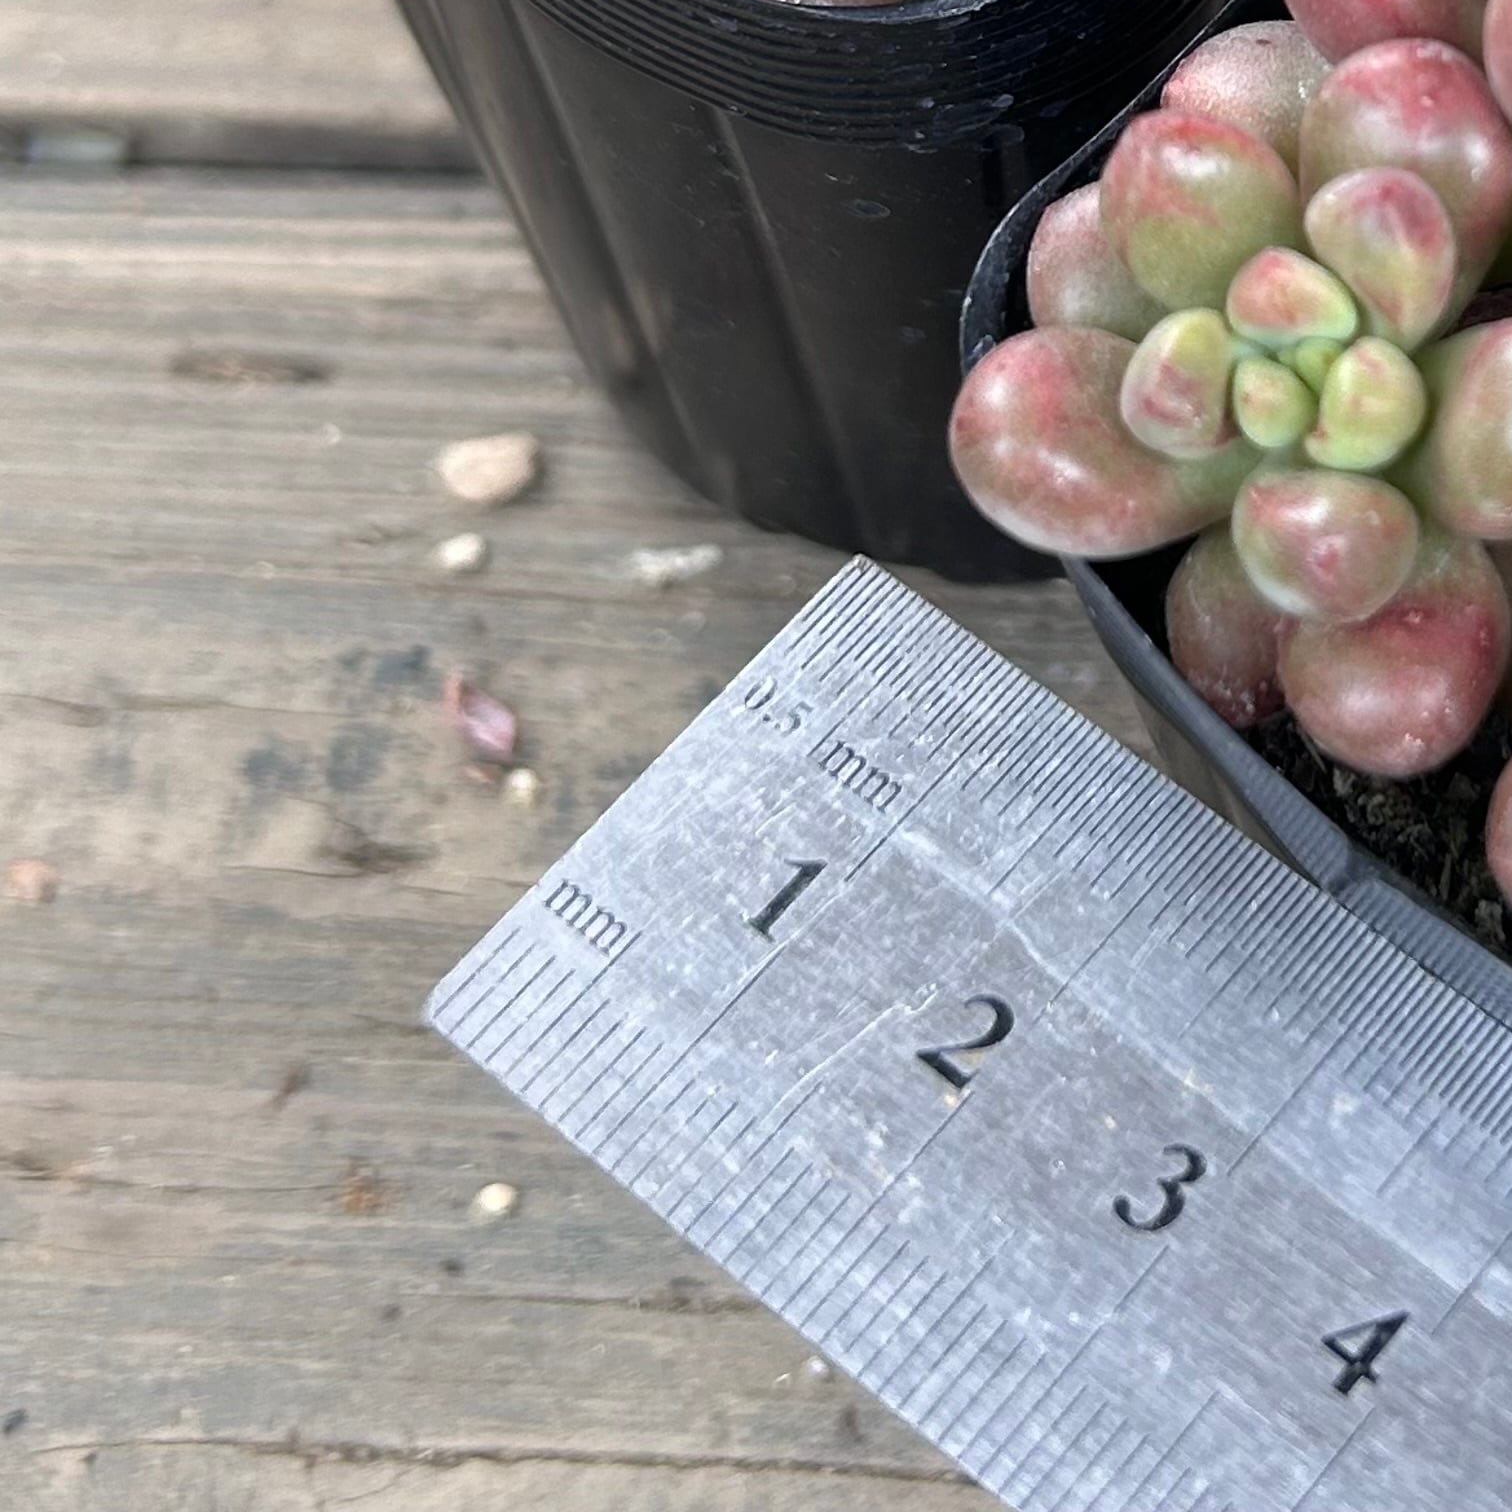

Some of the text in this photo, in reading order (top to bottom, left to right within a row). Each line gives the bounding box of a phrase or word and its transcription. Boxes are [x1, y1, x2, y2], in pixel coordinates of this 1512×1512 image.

[817, 739, 903, 815] mm
[542, 876, 631, 958] mm
[740, 856, 829, 944] 1
[916, 993, 1015, 1088] 2
[1111, 1142, 1208, 1232] 3
[1320, 1310, 1411, 1396] 4
